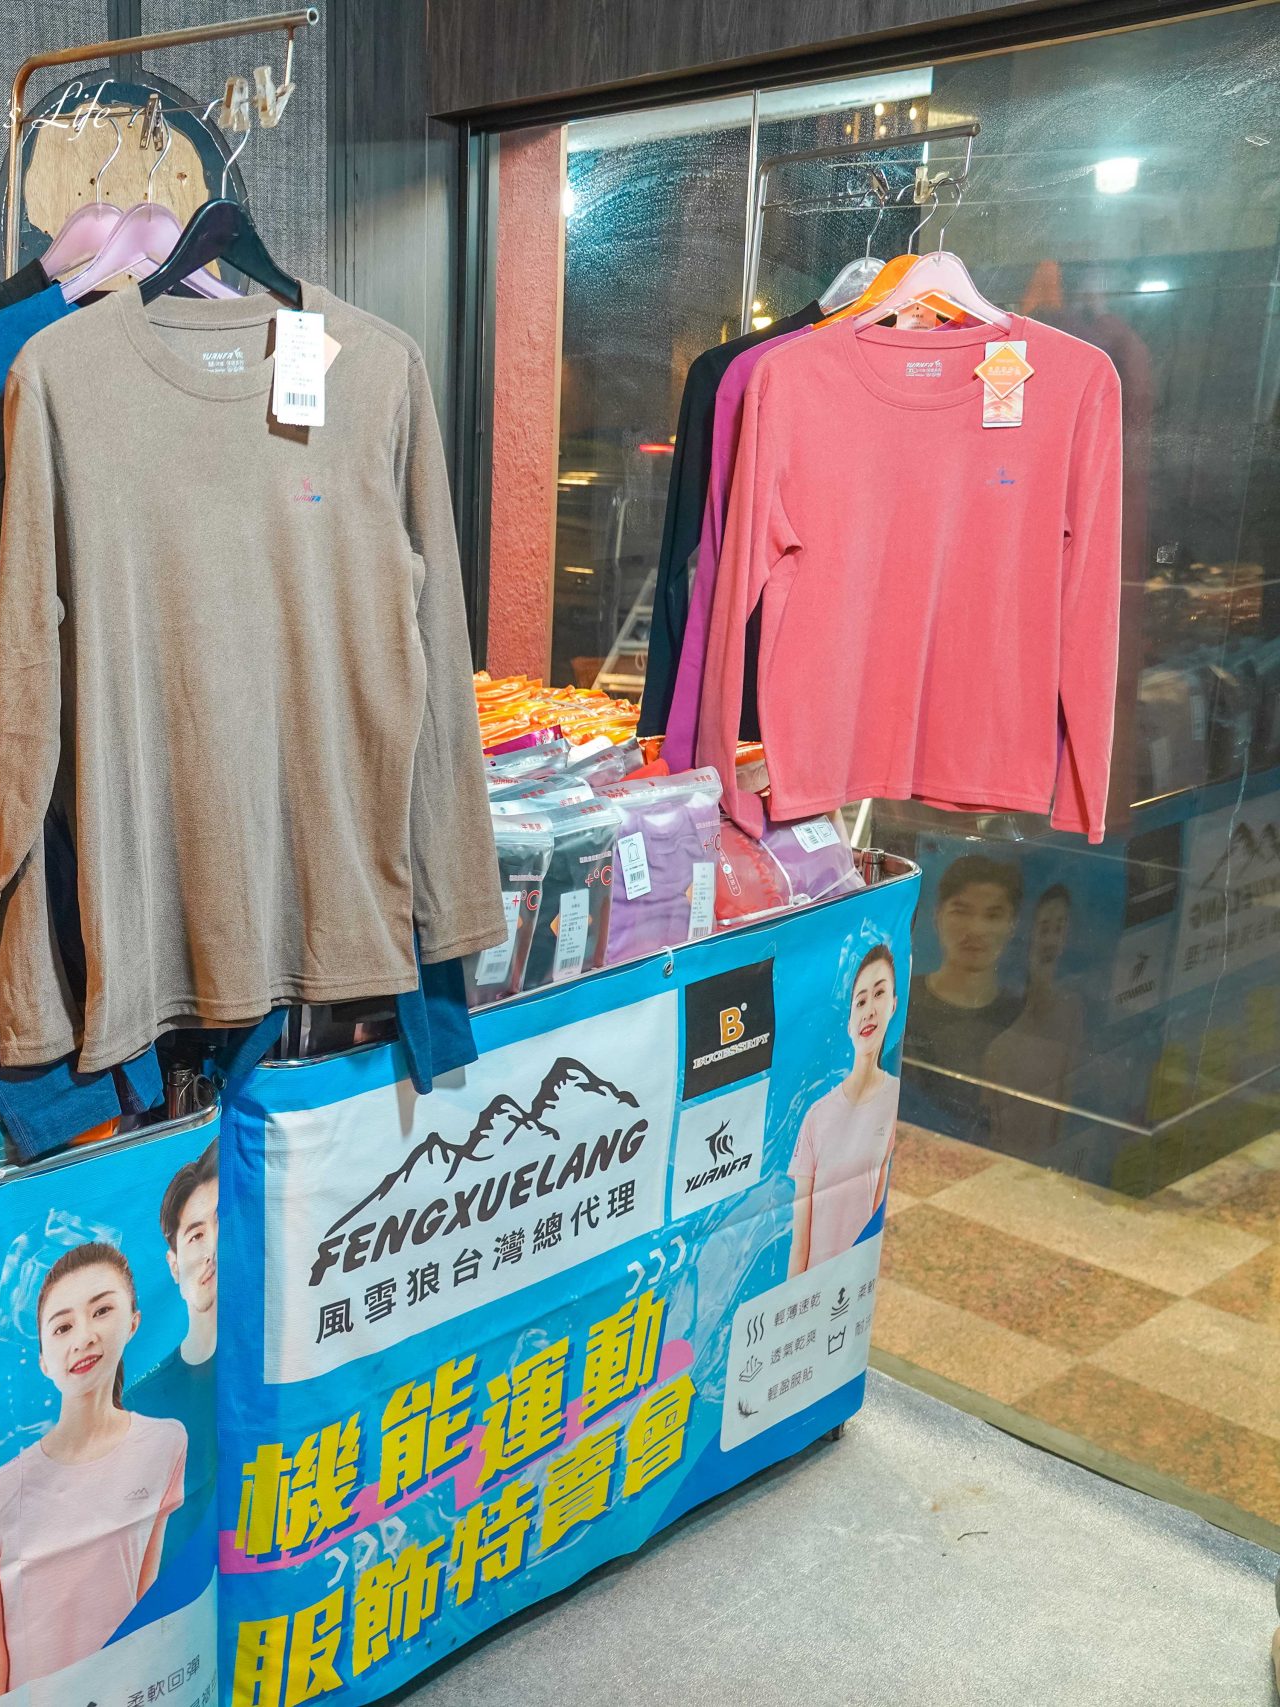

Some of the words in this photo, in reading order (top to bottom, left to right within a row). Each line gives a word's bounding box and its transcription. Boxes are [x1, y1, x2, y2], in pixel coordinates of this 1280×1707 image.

[719, 1005, 745, 1046] B
[684, 1153, 753, 1195] YUANFA
[308, 1118, 650, 1287] FENGXUELANG
[316, 1179, 637, 1345] 風雪狼台灣總代理
[773, 1291, 822, 1328] 輕薄速乾
[770, 1329, 817, 1366] 透氣乾爽
[767, 1366, 814, 1402] 輕盈服貼
[234, 1288, 673, 1562] 機能運動
[230, 1374, 699, 1707] 服飾特賣會
